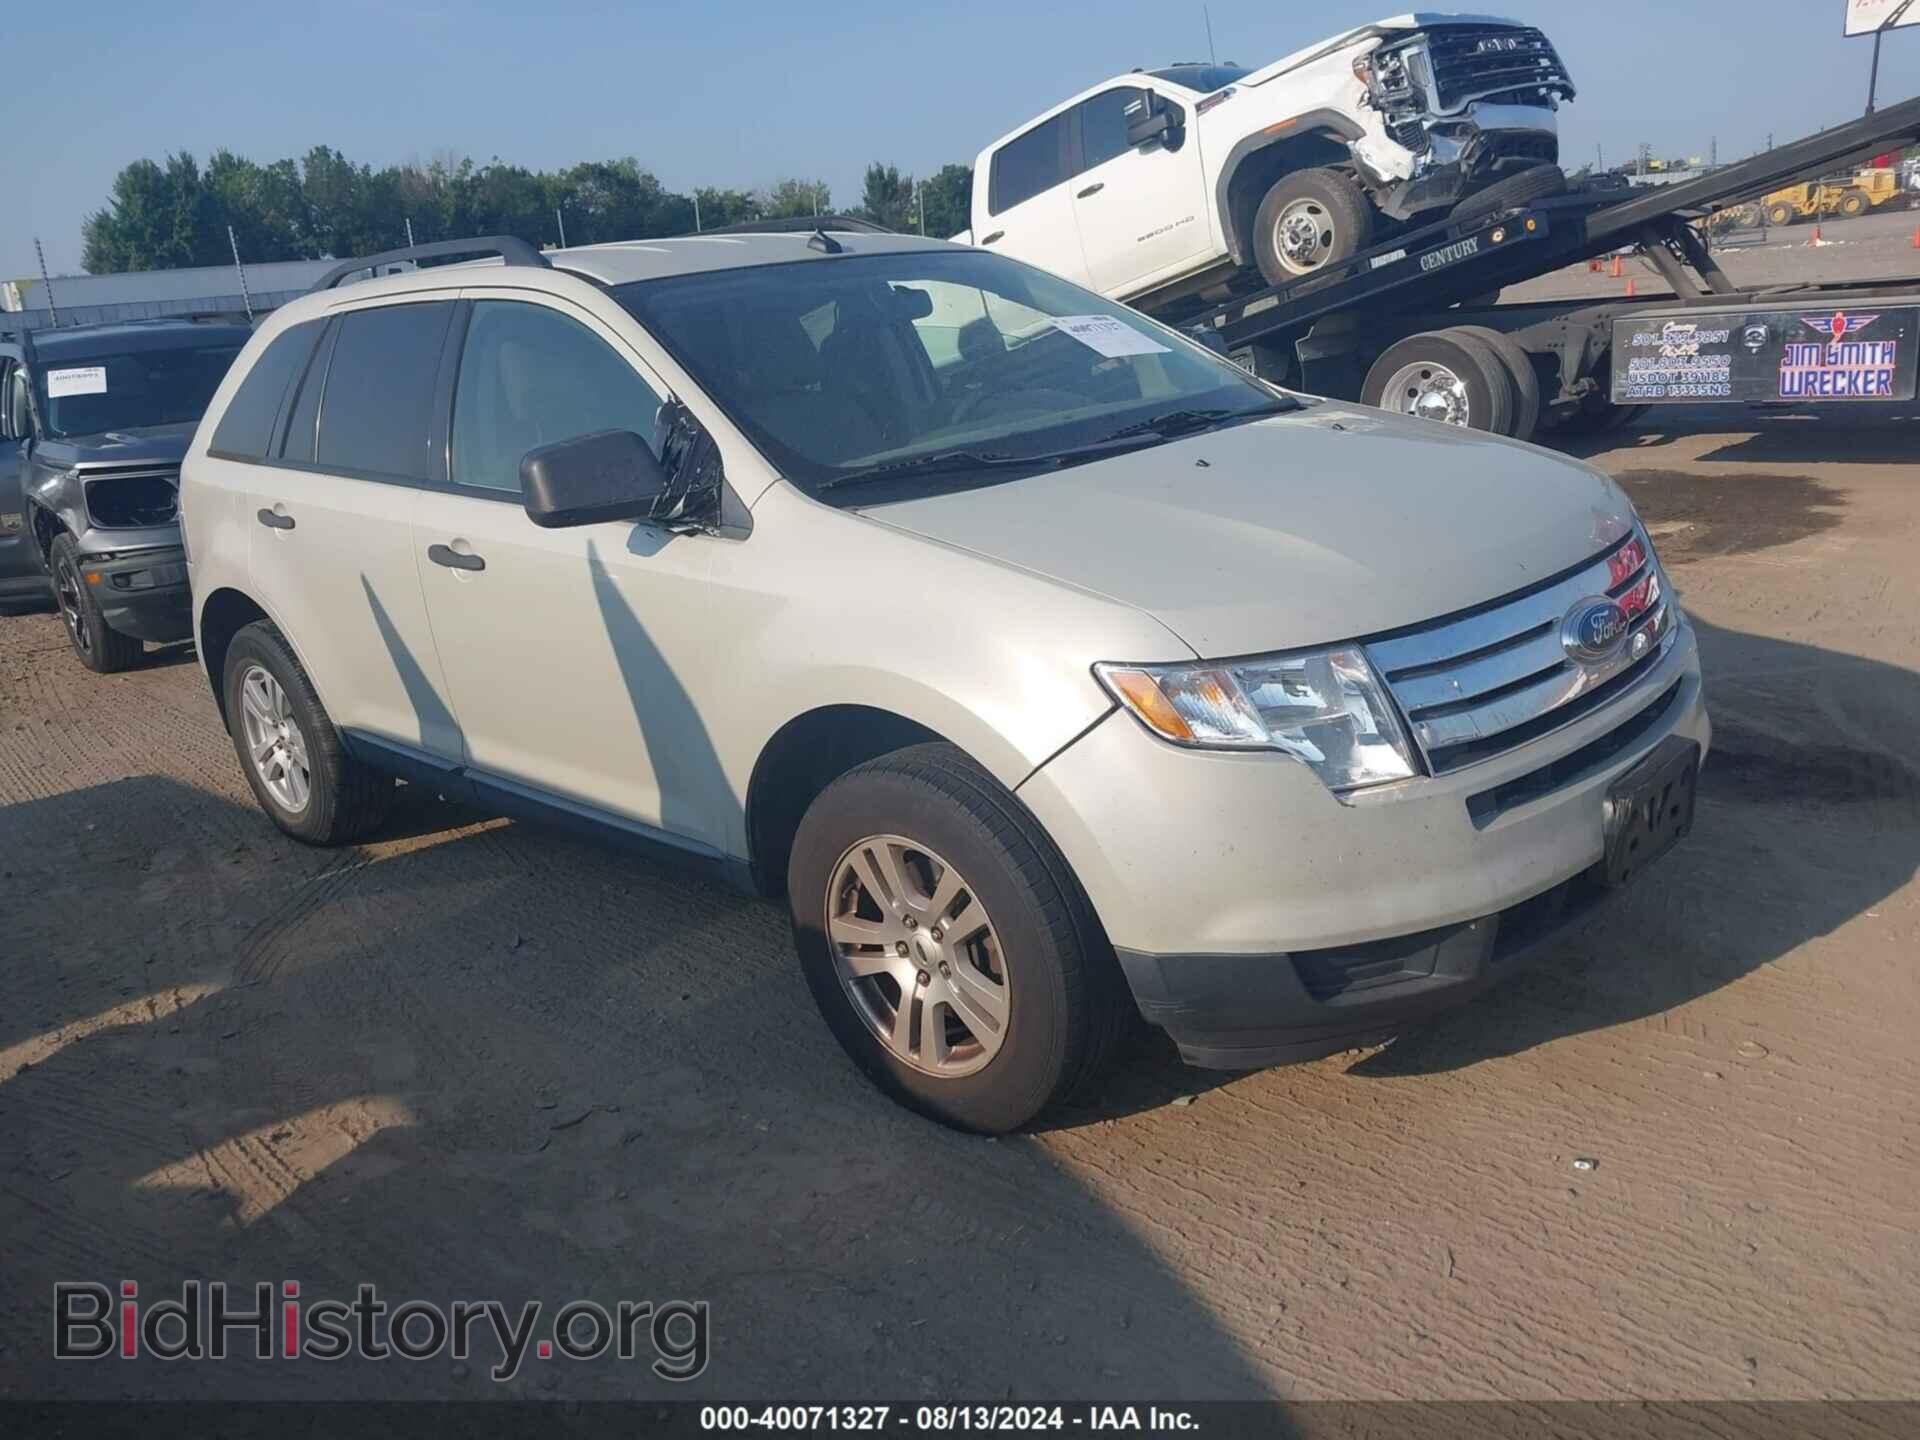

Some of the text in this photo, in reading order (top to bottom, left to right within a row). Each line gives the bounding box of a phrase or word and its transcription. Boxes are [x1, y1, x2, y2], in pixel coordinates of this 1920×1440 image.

[1420, 236, 1478, 270] CENTURY
[1781, 341, 1896, 367] JIM SMITH
[1628, 370, 1677, 384] USDOT
[1779, 368, 1892, 397] WRECKER
[1591, 610, 1628, 645] Ford
